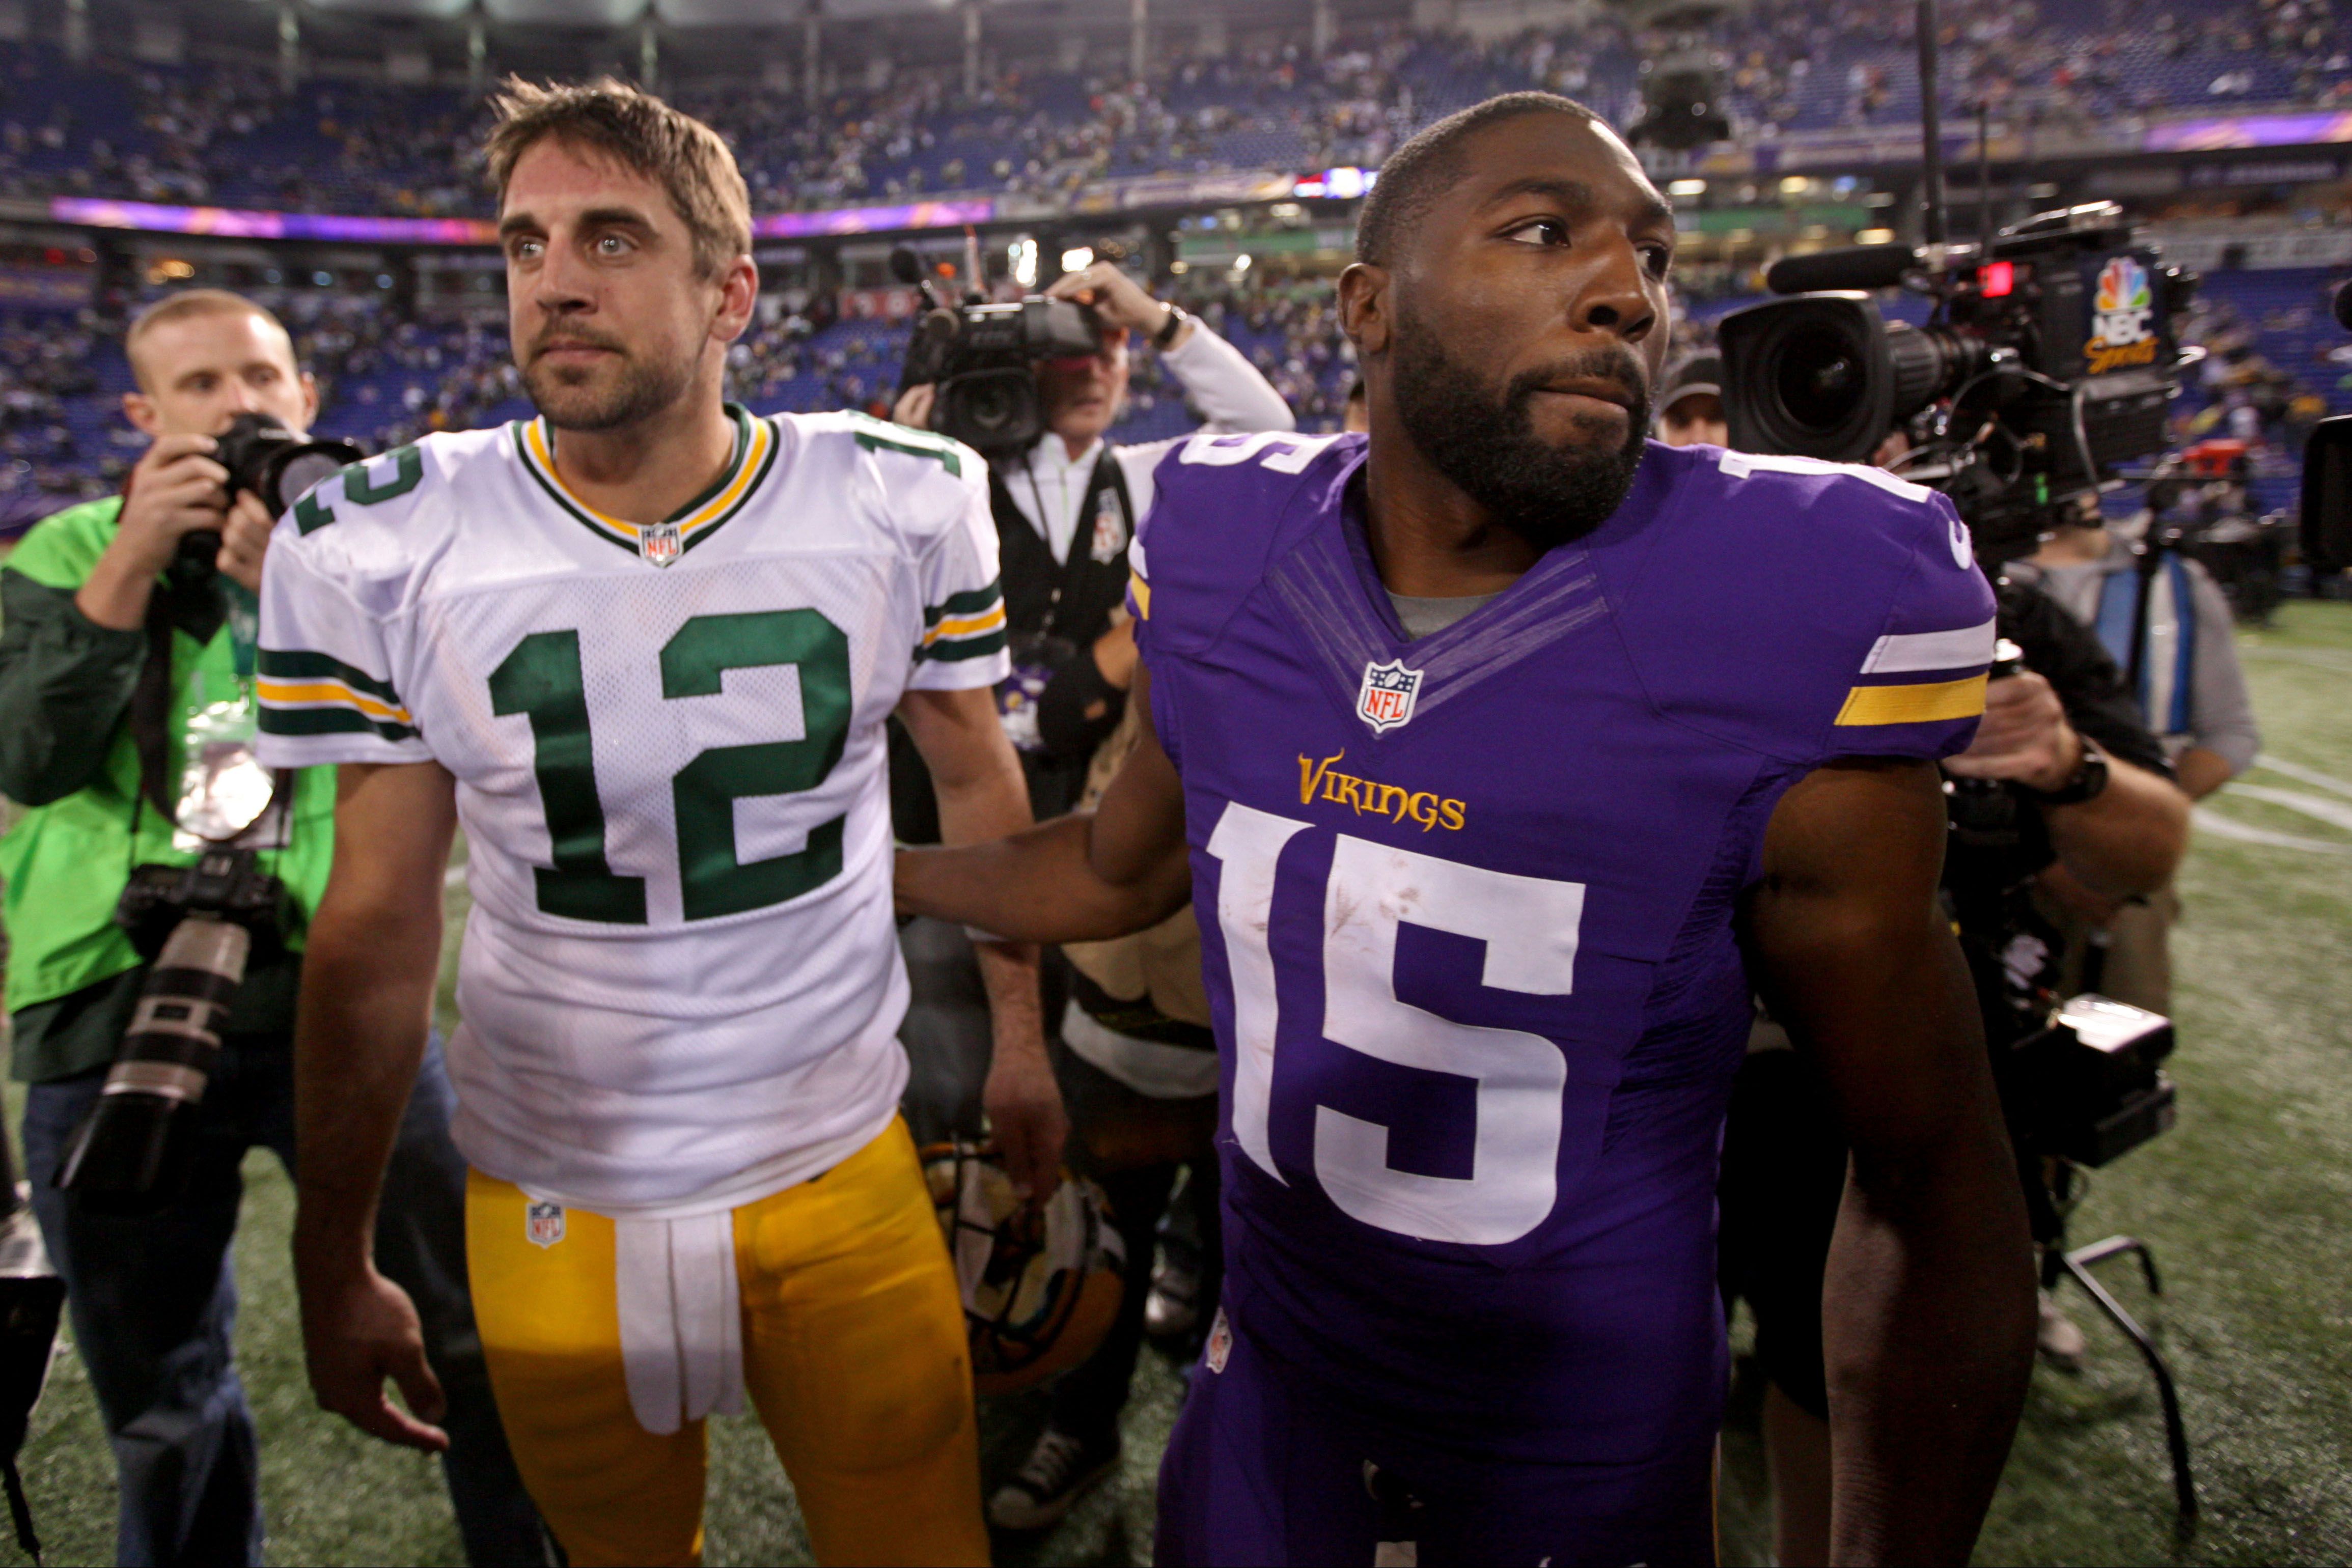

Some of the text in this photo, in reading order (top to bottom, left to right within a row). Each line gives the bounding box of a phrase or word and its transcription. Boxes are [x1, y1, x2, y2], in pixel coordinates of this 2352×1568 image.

[2093, 310, 2153, 346] NBC
[646, 537, 678, 559] NFL
[1365, 689, 1404, 720] NFL
[488, 607, 852, 926] 12
[1206, 800, 1587, 1246] 15
[533, 1219, 560, 1239] NFL
